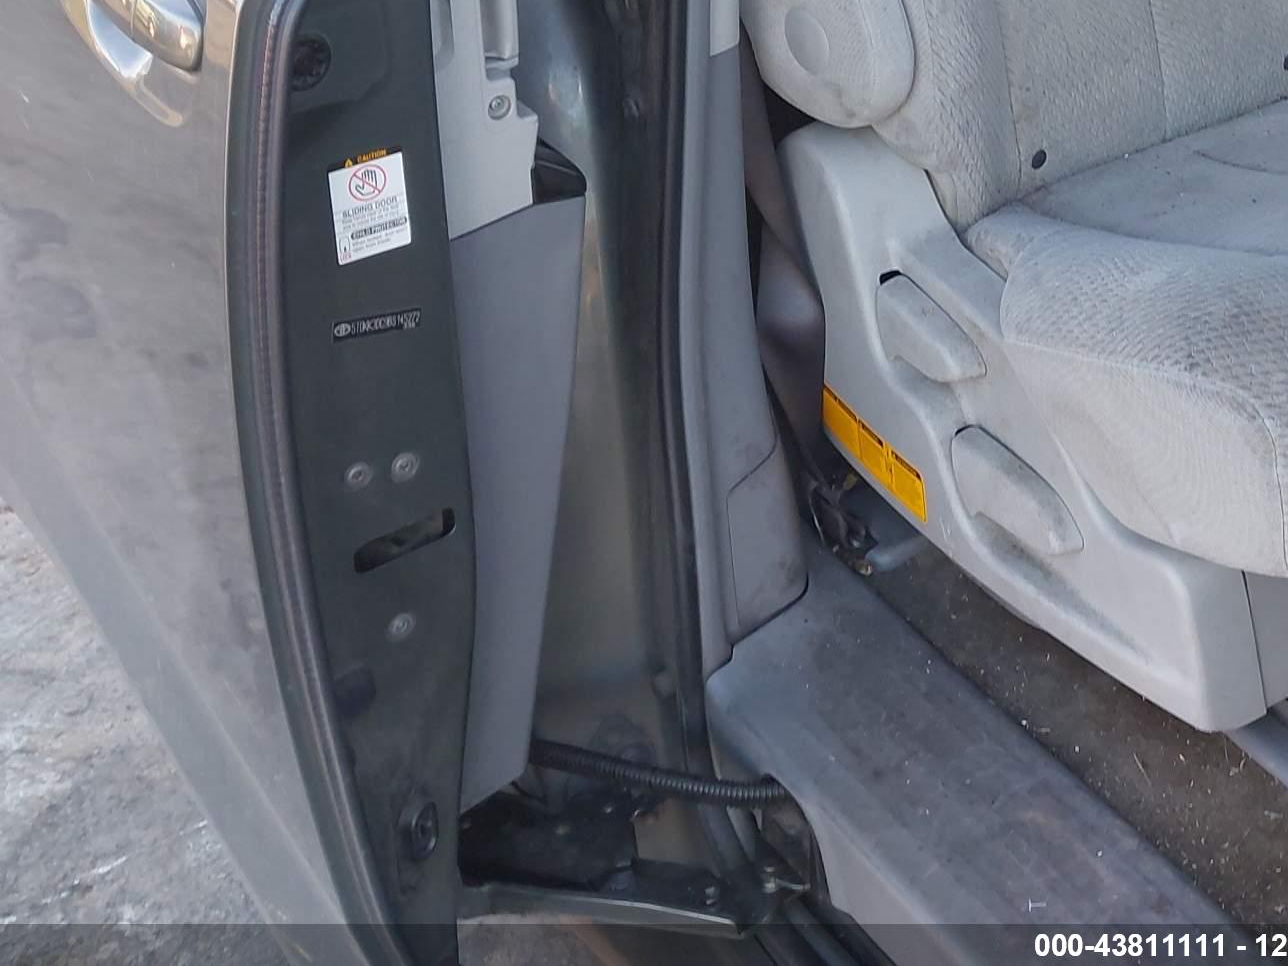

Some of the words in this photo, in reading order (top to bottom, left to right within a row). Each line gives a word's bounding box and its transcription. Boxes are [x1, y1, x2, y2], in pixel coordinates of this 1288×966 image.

[357, 148, 387, 163] CAUTION
[342, 203, 374, 218] SLIDING
[375, 195, 398, 209] DOOR
